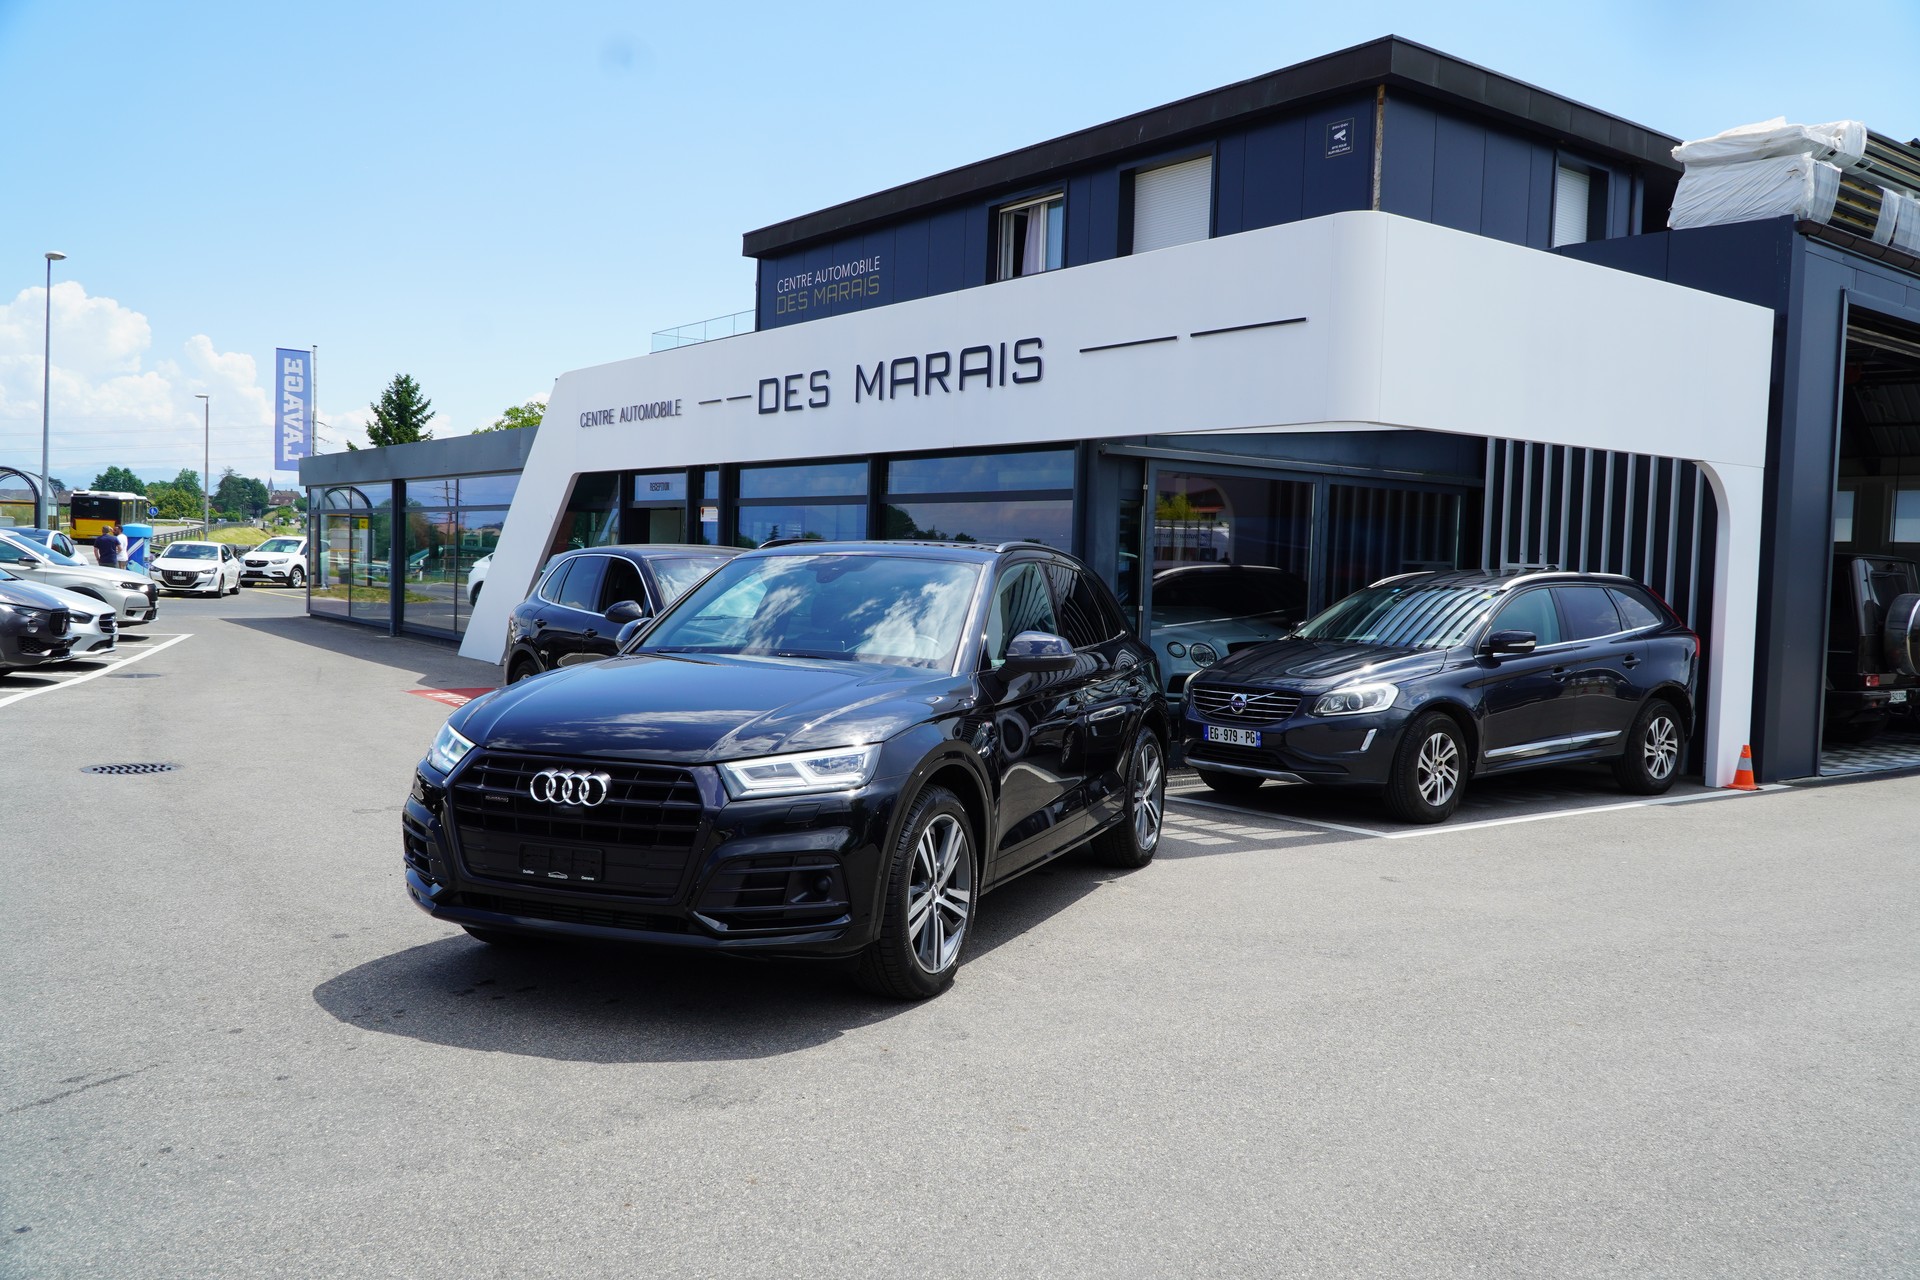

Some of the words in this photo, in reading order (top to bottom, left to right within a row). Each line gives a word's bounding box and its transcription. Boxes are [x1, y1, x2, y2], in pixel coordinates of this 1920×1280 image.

[777, 272, 812, 293] CENTRE
[815, 255, 880, 284] AUTOMOBILE
[776, 291, 808, 314] DES
[813, 275, 879, 306] MARAIS
[580, 408, 615, 427] CENTRE
[619, 399, 682, 423] AUTOMOBILE
[758, 369, 831, 415] DES
[855, 337, 1043, 403] MARAIS
